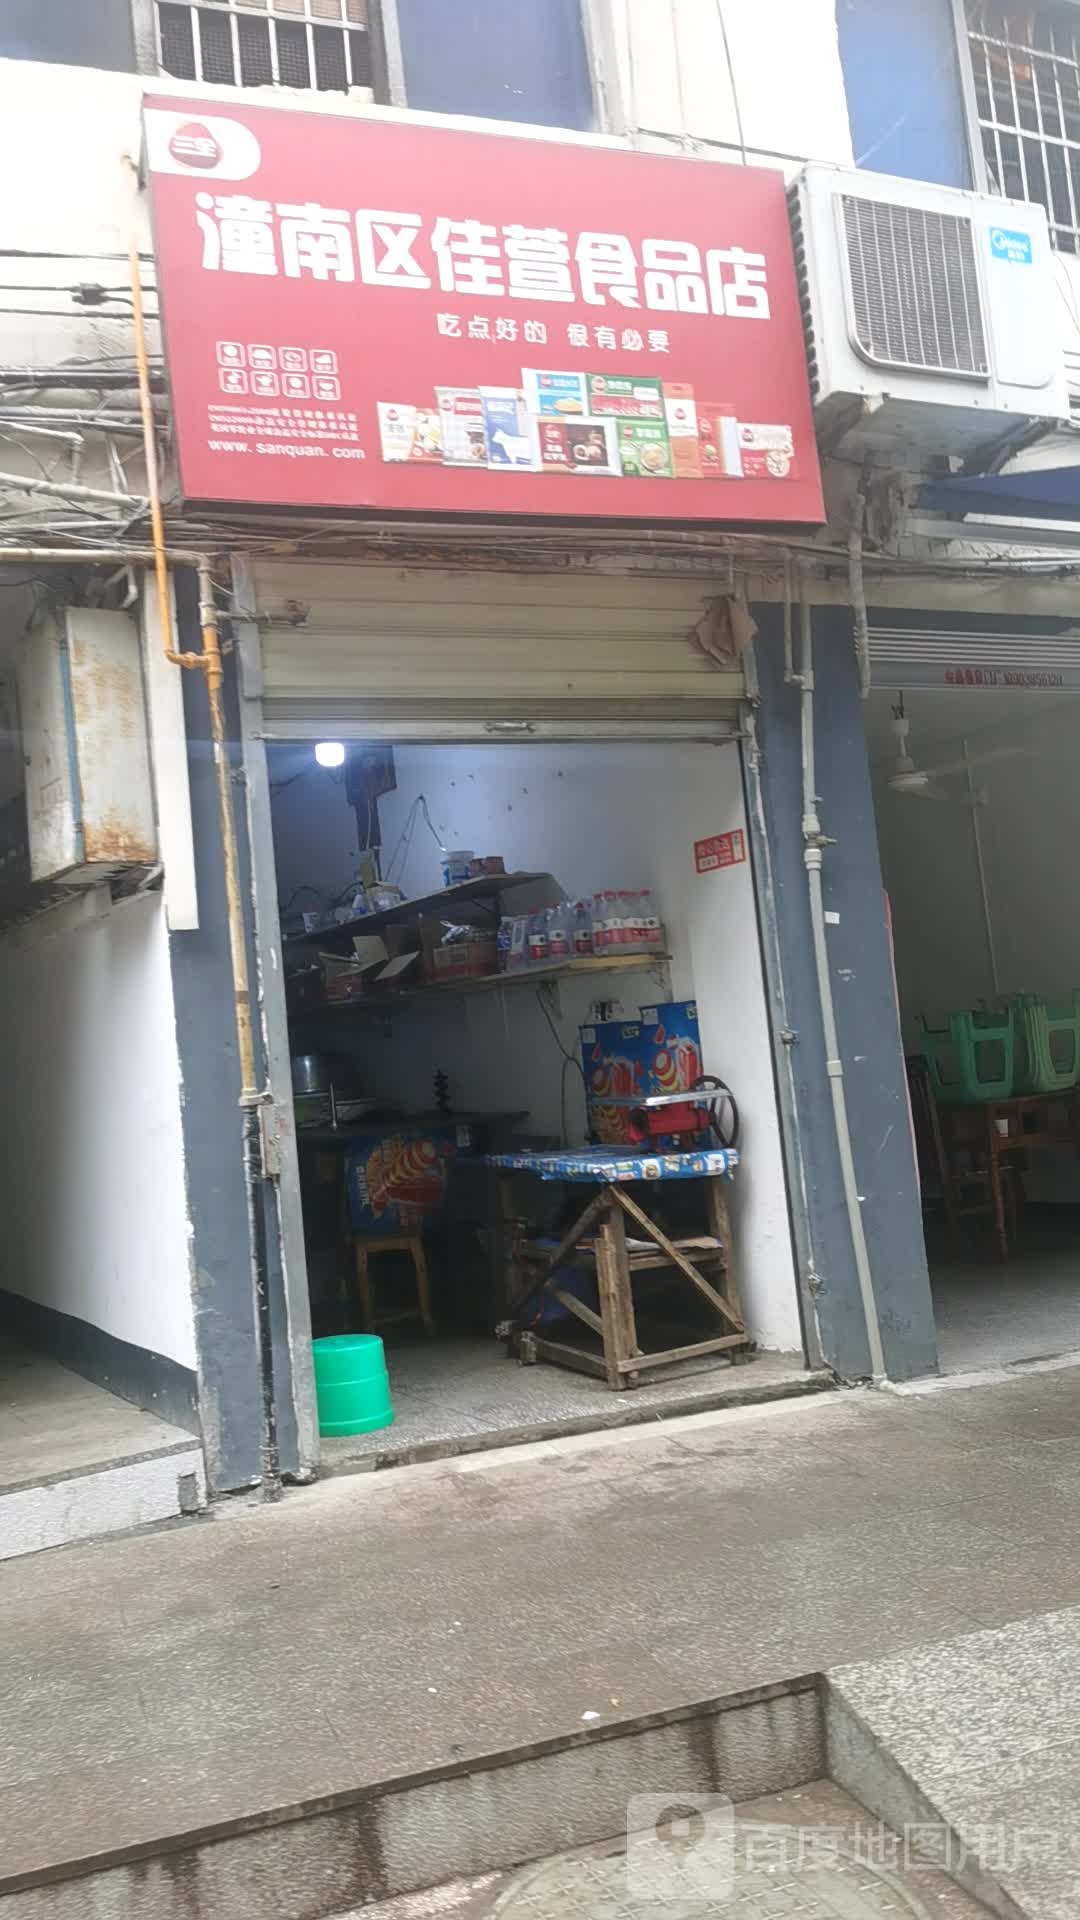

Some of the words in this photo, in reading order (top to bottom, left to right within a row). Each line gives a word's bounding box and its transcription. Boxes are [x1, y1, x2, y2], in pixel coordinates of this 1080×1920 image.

[195, 191, 770, 319] 潼南区佳萱食品店
[437, 313, 548, 344] 吃点好的
[567, 323, 670, 352] 很有必要
